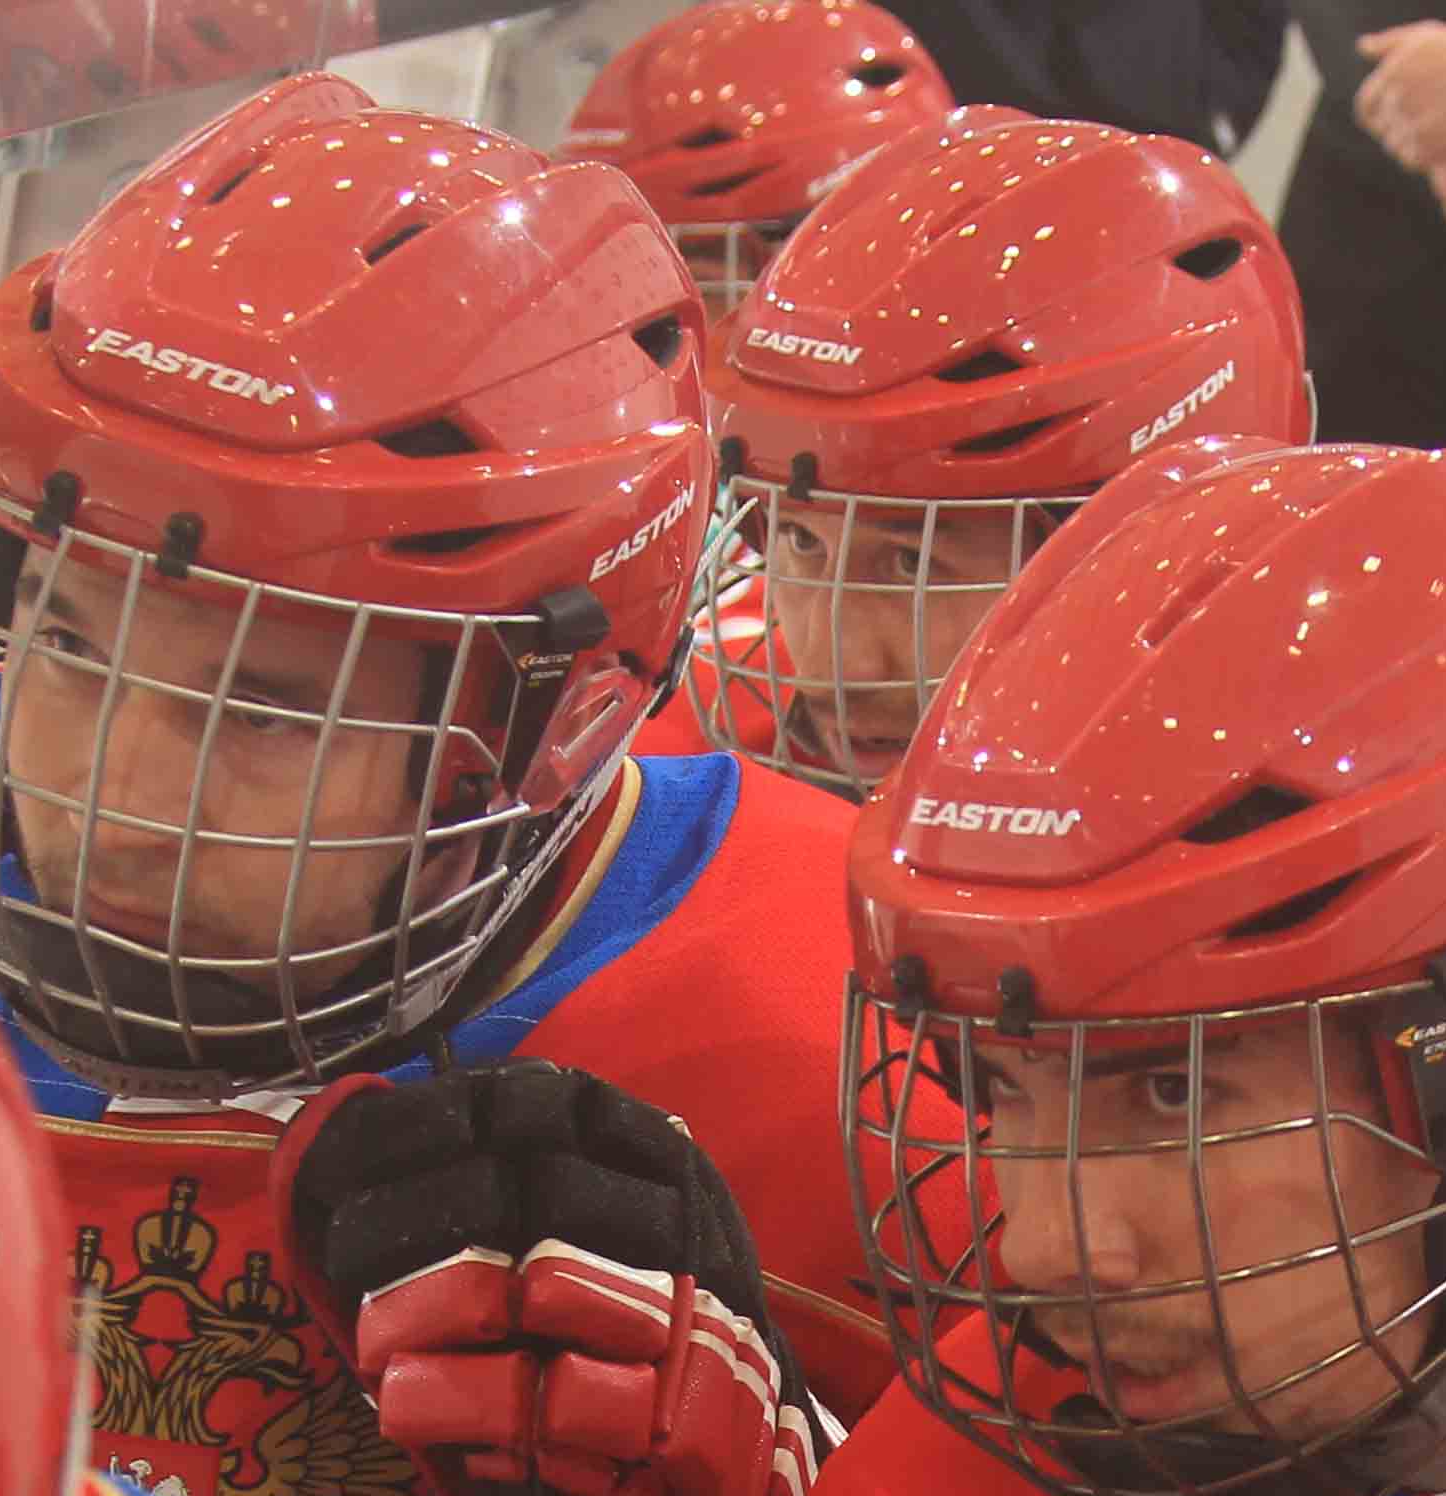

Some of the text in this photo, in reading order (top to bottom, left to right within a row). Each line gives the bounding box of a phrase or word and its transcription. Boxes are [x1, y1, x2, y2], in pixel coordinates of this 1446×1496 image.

[92, 328, 295, 406] EASTON
[746, 328, 861, 366] EASTON
[1128, 361, 1235, 455] EASTON
[589, 486, 696, 584] EASTON
[911, 797, 1079, 837] EASTON
